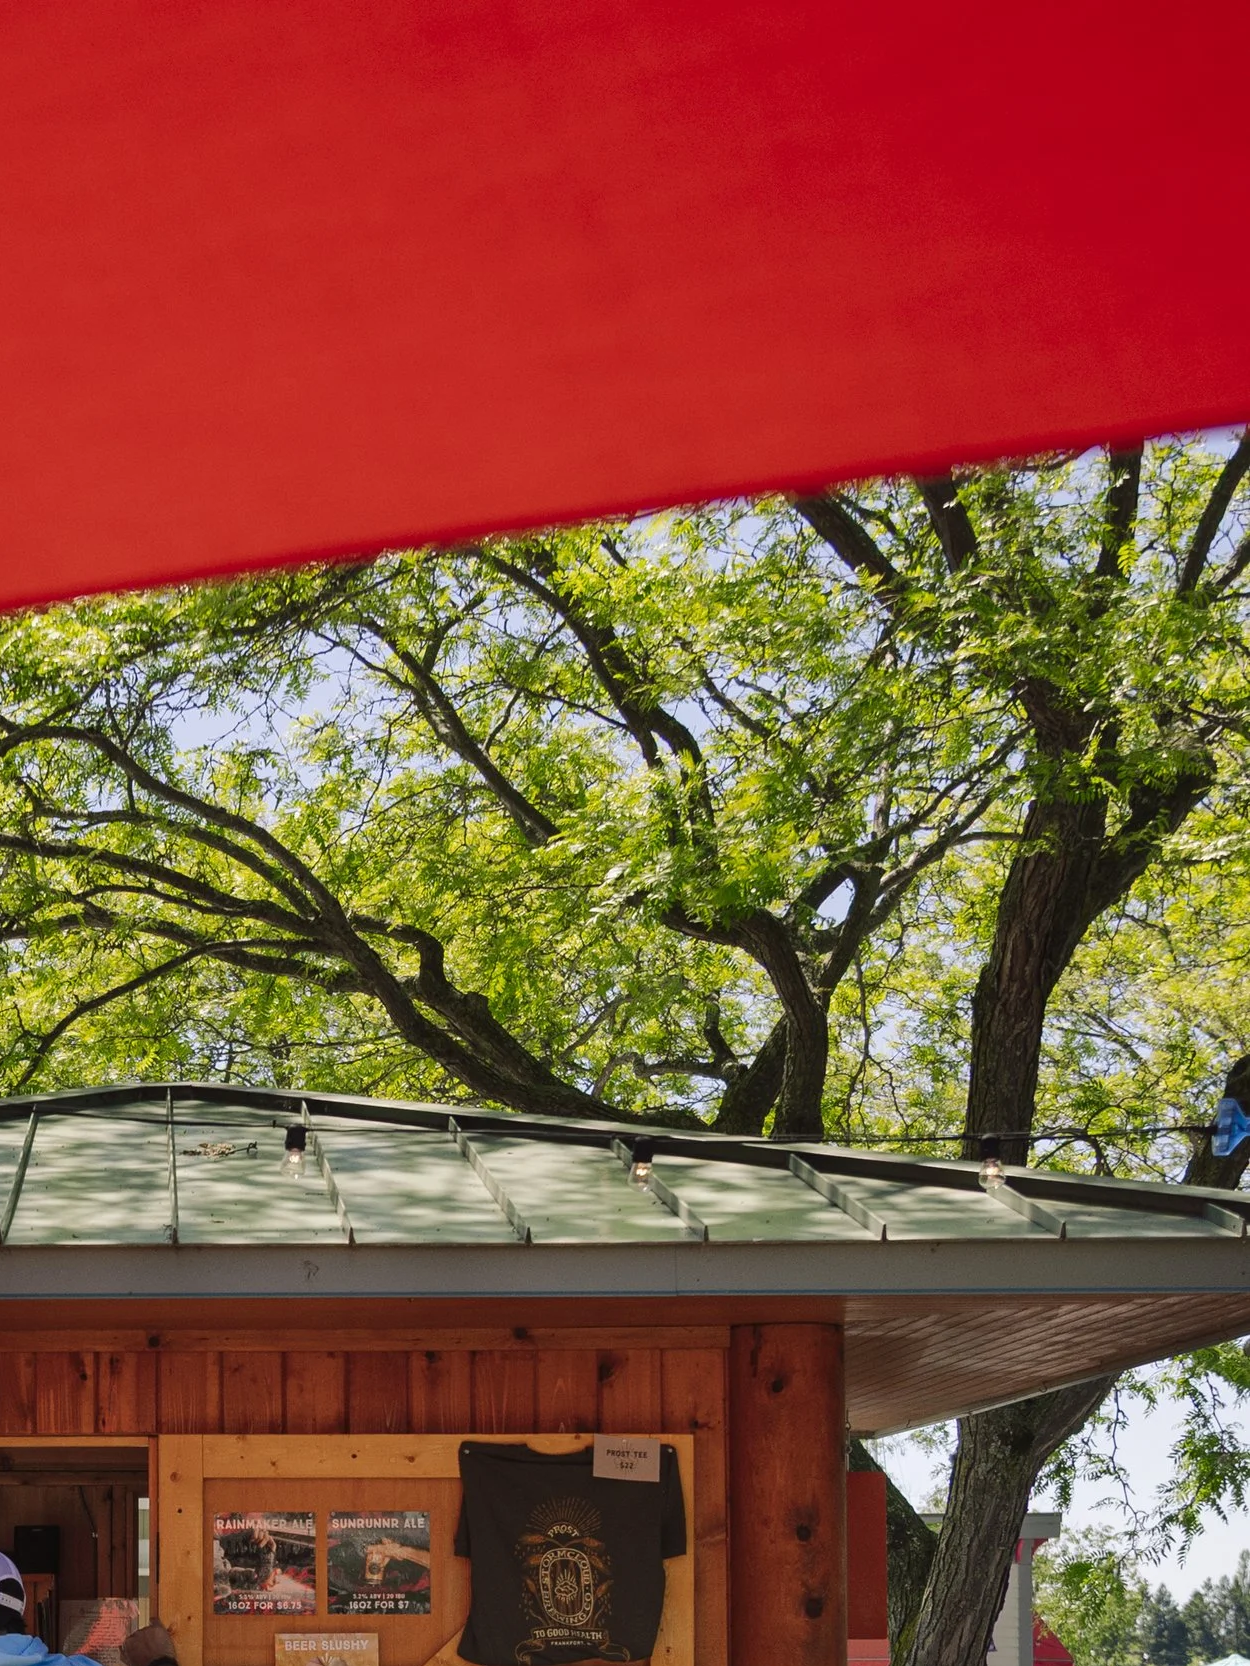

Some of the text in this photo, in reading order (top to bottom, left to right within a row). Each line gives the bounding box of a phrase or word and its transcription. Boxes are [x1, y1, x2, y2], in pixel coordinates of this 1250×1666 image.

[606, 1449, 630, 1458] PROST
[216, 1519, 313, 1530] RAINMAKER ALE
[332, 1518, 425, 1529] SUNRUNNR ALE
[547, 1524, 580, 1538] PROST
[540, 1549, 591, 1585] STORMCLOUD
[228, 1601, 302, 1610] 16OZ FOR $6.75
[349, 1600, 410, 1609] 16OZ FOR $7
[534, 1628, 603, 1640] TO GOOD HEALTH
[285, 1640, 369, 1651] BEER SLUSHY
